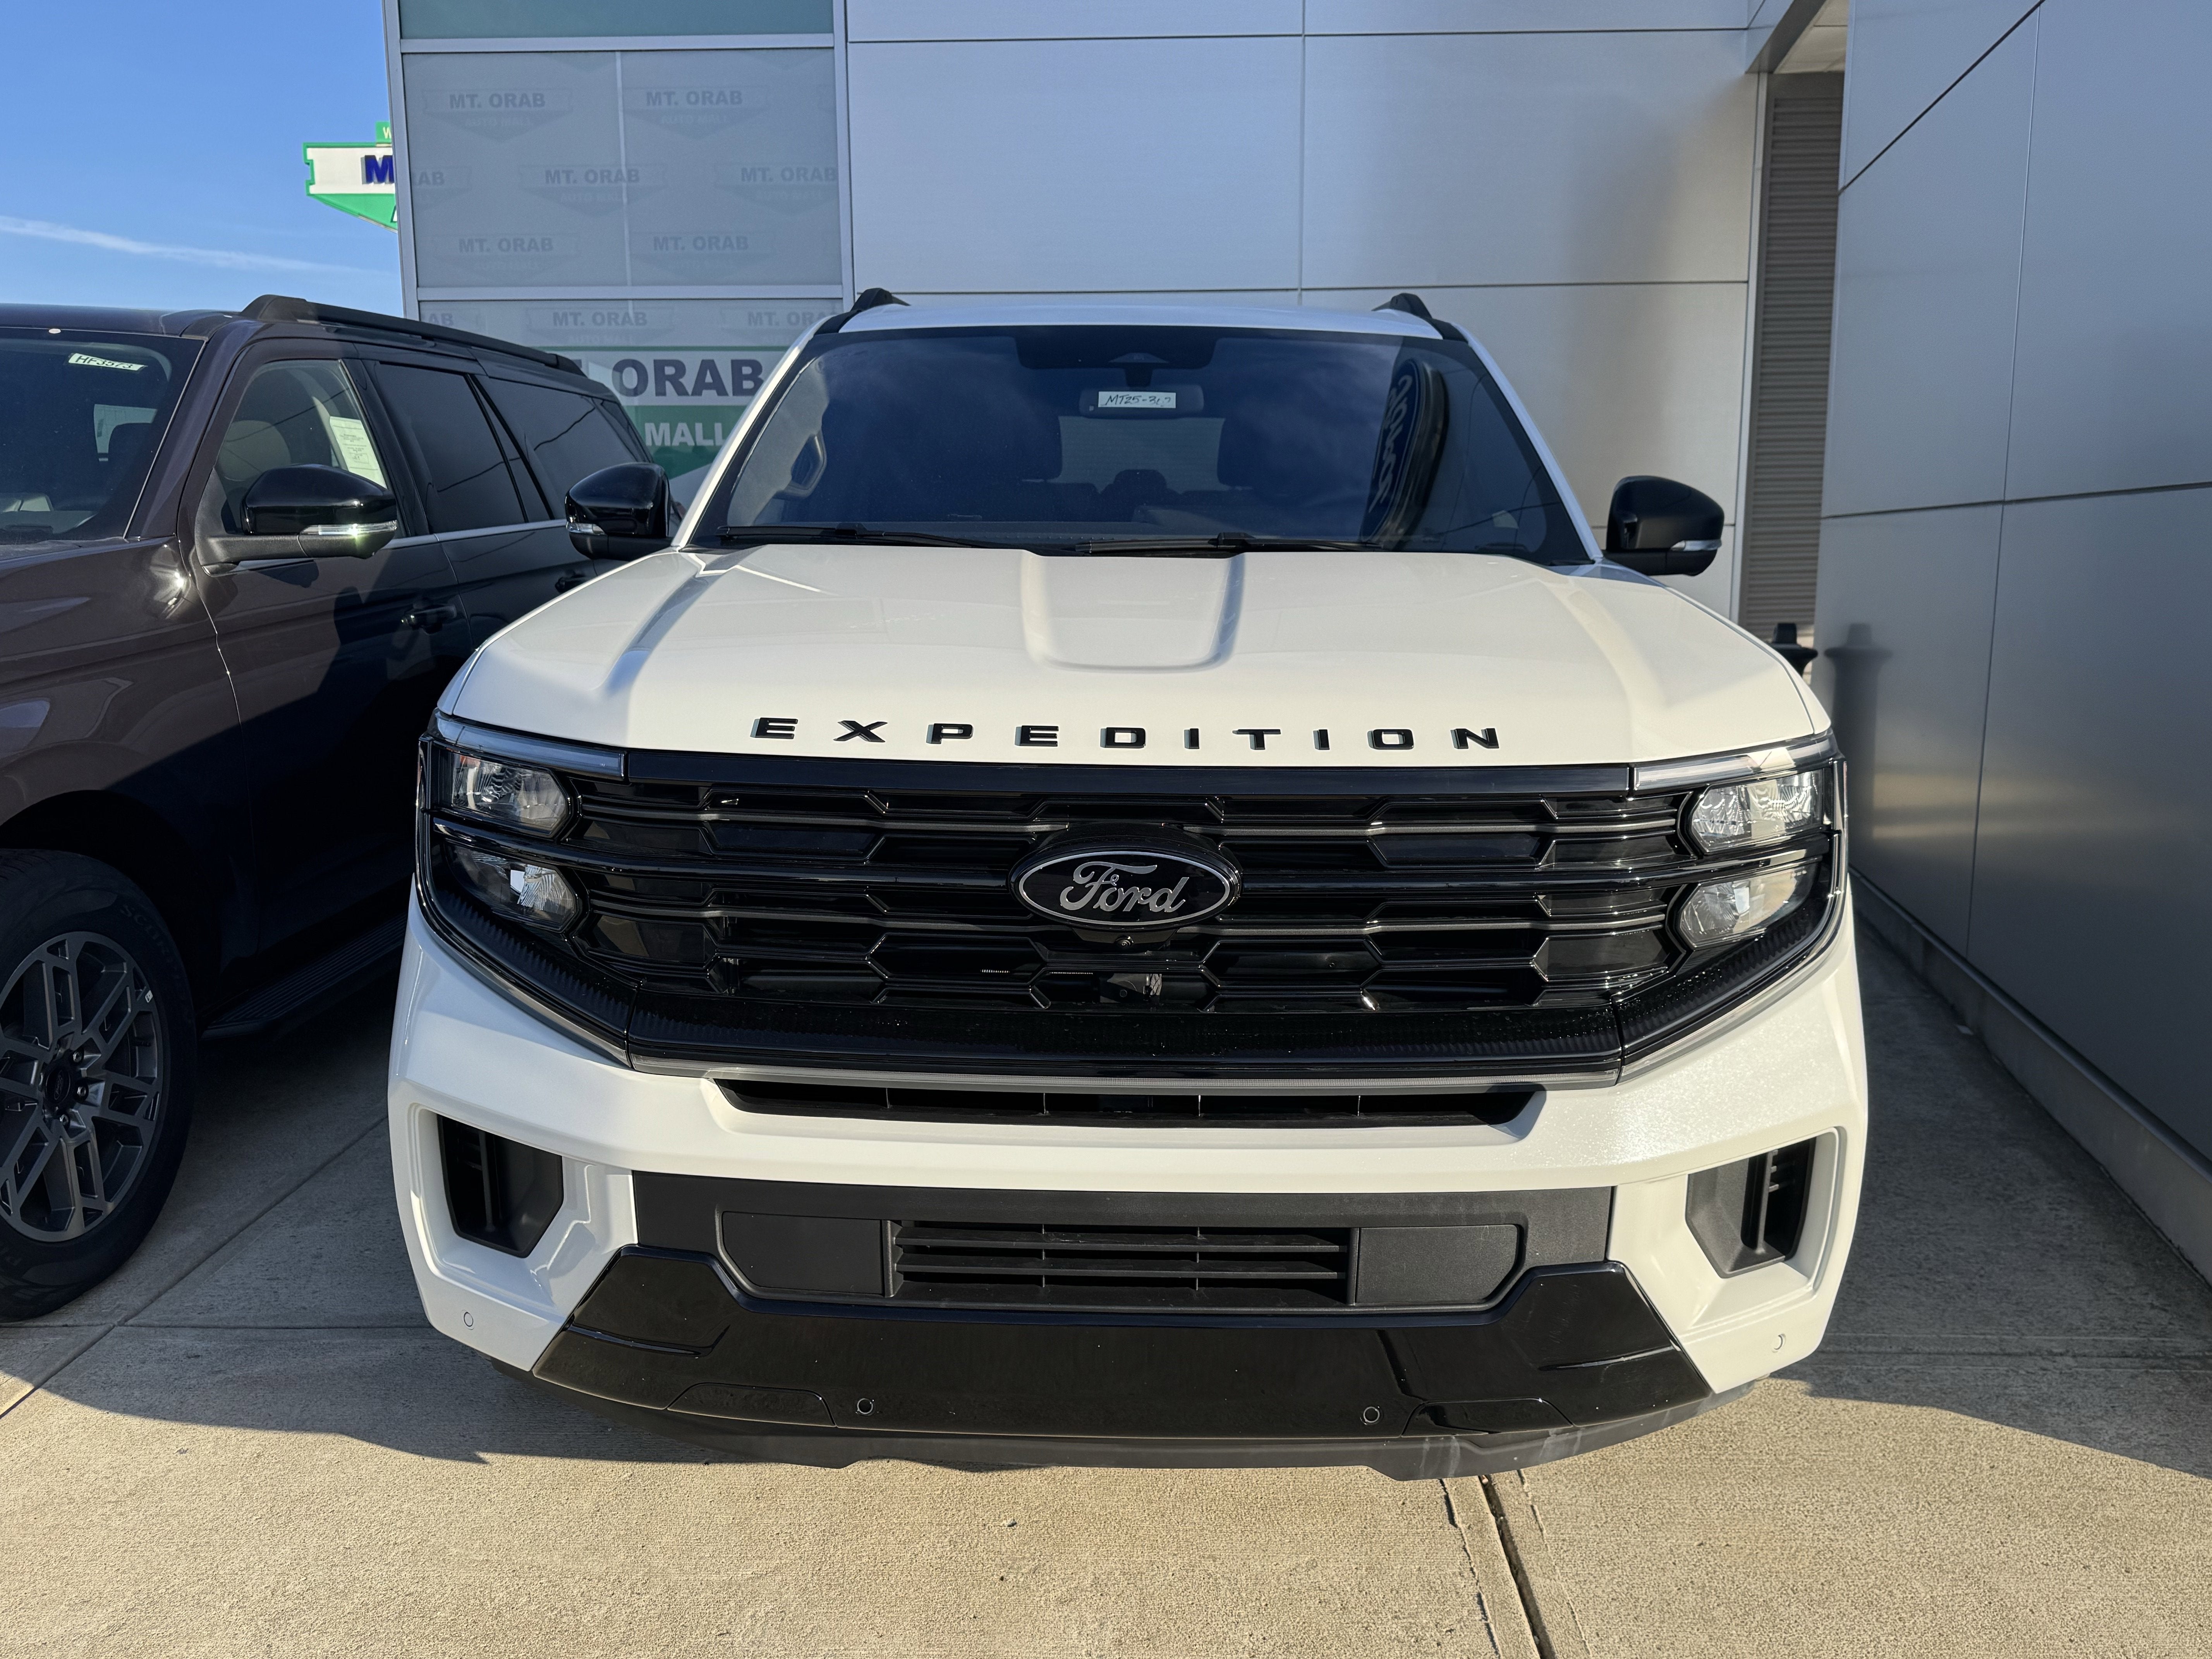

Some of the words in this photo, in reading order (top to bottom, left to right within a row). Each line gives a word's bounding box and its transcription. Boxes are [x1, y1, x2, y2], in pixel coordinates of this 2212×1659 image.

[449, 93, 482, 109] MT.
[489, 93, 546, 108] ORAB
[646, 91, 679, 106] MT.
[685, 90, 743, 106] ORAB
[544, 170, 578, 185] MT.
[584, 168, 640, 184] ORAB
[740, 168, 774, 182] MT.
[780, 167, 838, 182] ORAB
[459, 238, 490, 253] MT.
[497, 237, 554, 252] ORAB
[653, 236, 685, 251] MT.
[692, 235, 749, 251] ORAB
[420, 313, 454, 325] AB
[553, 312, 586, 326] MT.
[591, 311, 648, 326] ORAB
[748, 311, 780, 326] MT.
[787, 311, 831, 326] OR
[612, 359, 764, 397] ORAB
[644, 422, 726, 446] MALL
[751, 717, 1499, 750] EXPEDITION
[1060, 861, 1190, 912] Ford
